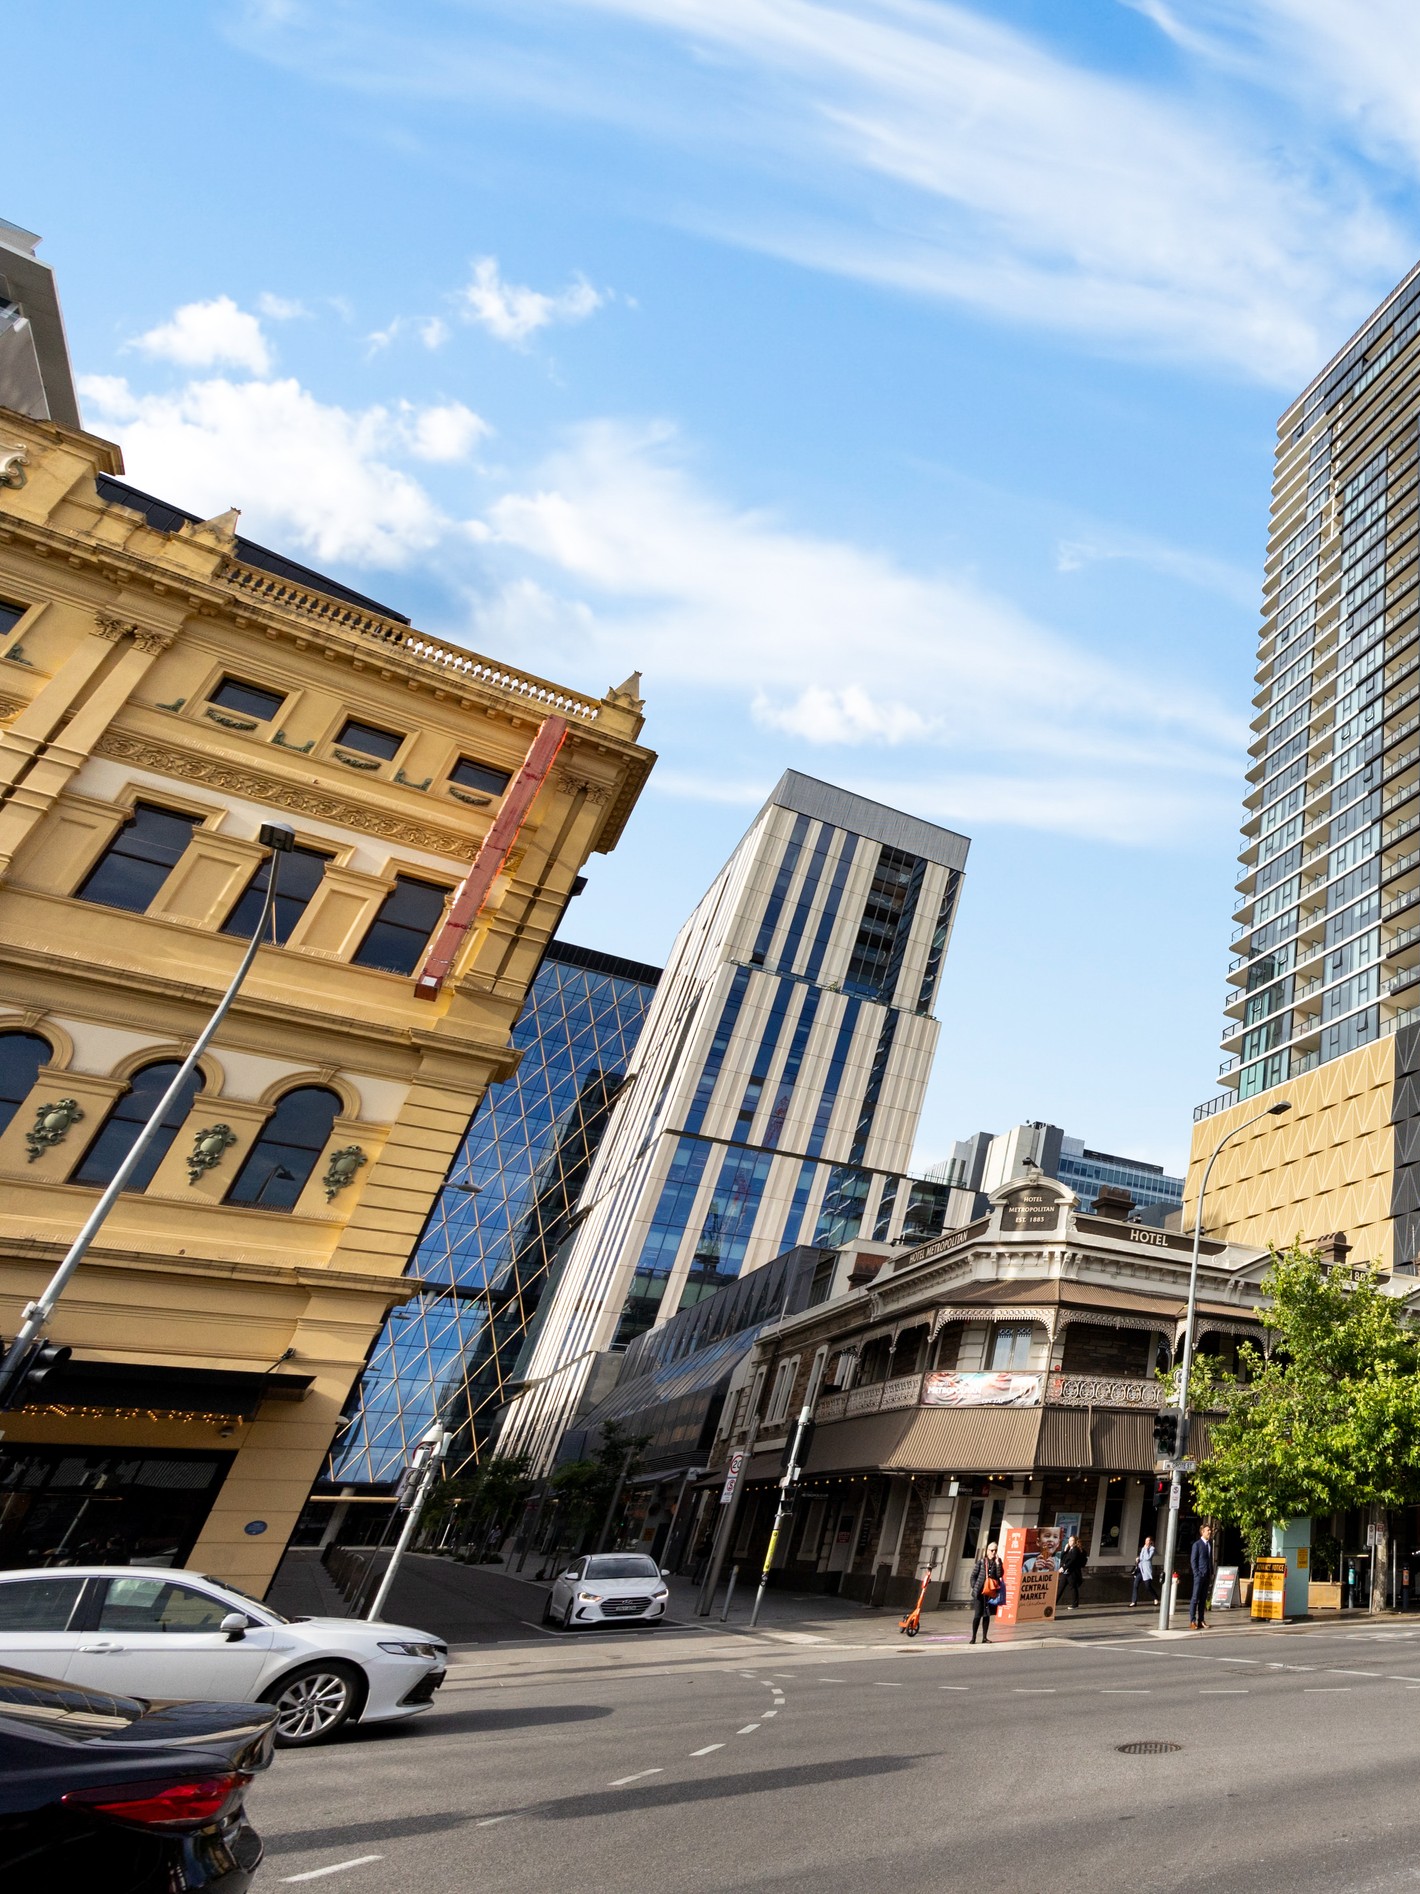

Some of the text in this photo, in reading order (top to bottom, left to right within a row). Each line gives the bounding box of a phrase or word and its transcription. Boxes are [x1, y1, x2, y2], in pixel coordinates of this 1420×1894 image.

[1130, 1229, 1169, 1246] HOTEL
[908, 1230, 969, 1264] HOTEL METROPOLITAN
[732, 1460, 742, 1469] 20
[1272, 1564, 1284, 1572] NOTICE
[1022, 1574, 1053, 1583] ADELAIDE
[1021, 1583, 1049, 1592] CENTRAL
[1020, 1591, 1047, 1601] MARKET
